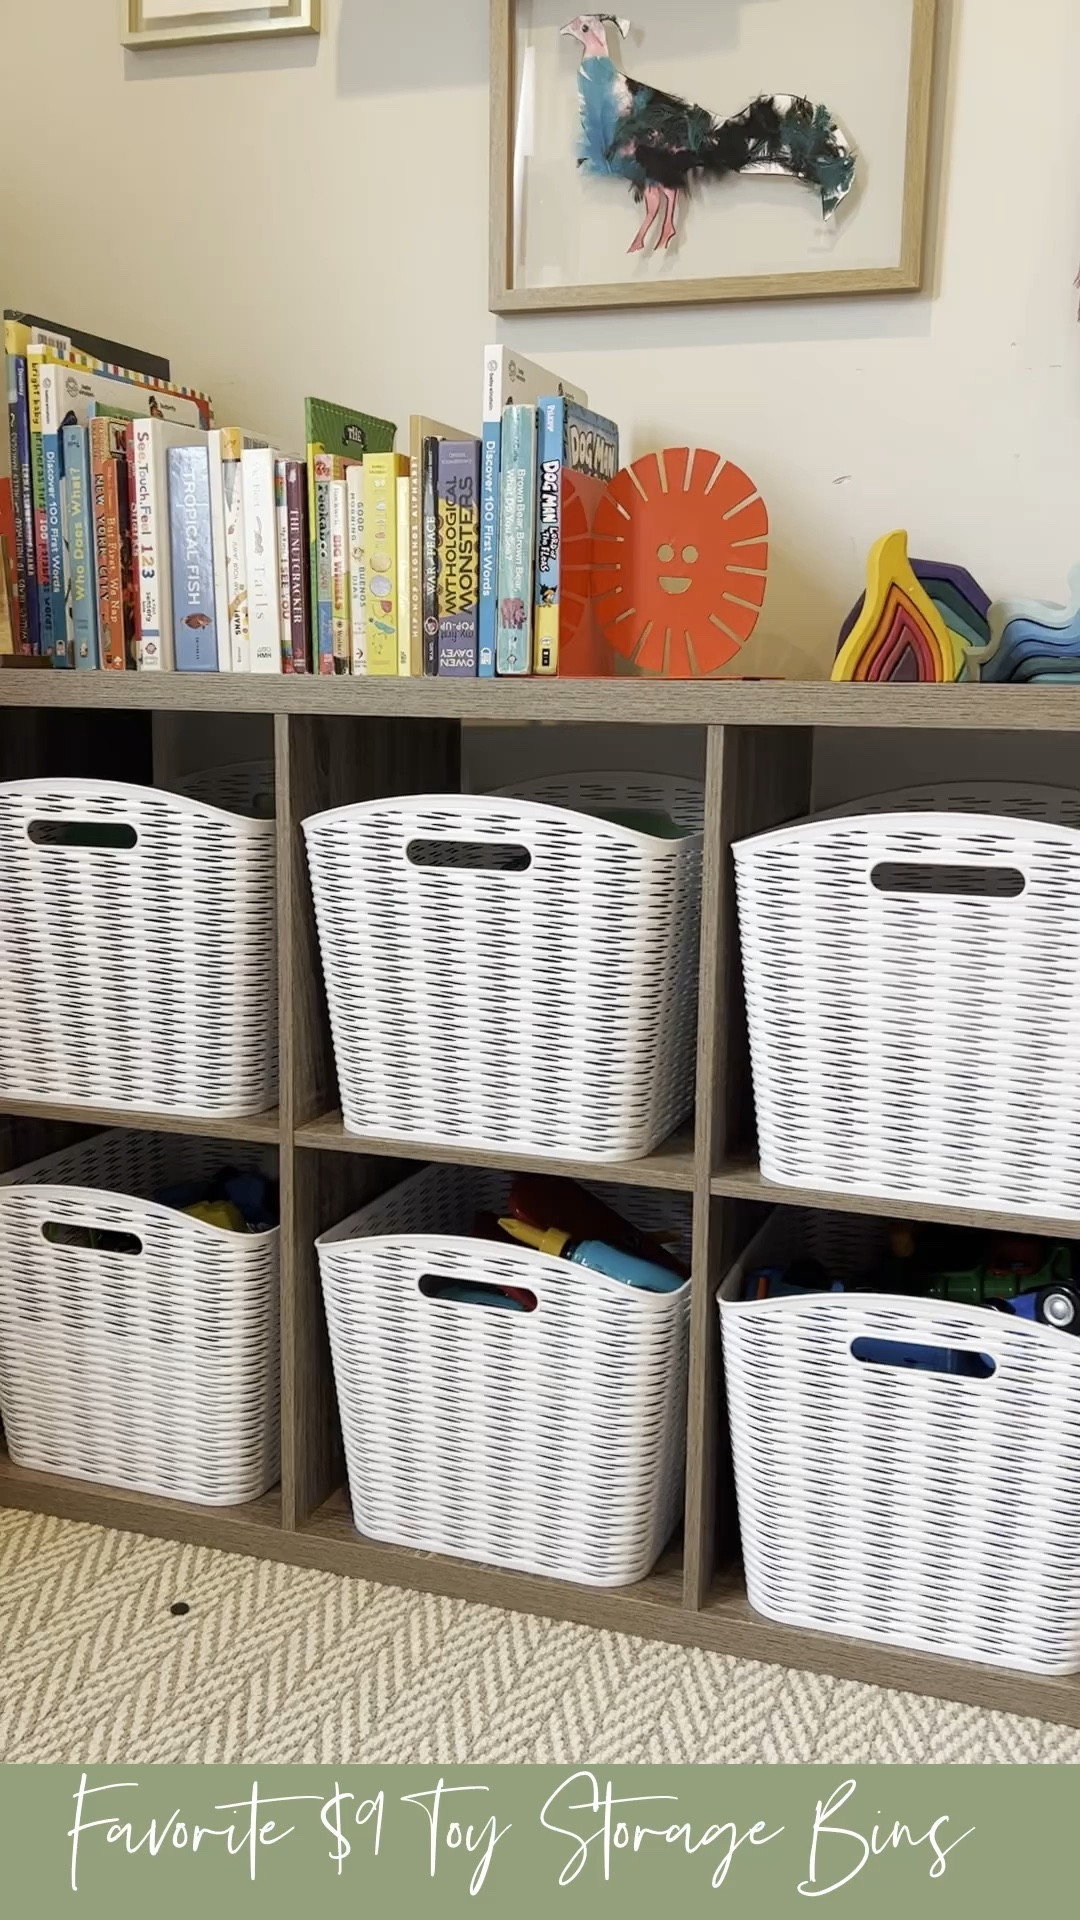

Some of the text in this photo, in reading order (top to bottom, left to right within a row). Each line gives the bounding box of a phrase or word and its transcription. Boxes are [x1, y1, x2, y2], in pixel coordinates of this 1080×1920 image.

[30, 362, 42, 425] bright baby
[569, 424, 616, 480] DOG MAN
[94, 473, 105, 506] NEW
[541, 459, 560, 523] DOG MAN
[39, 518, 49, 540] 100
[46, 451, 62, 593] Discover 100 First Words
[69, 467, 86, 601] Who Does What?
[96, 514, 108, 556] YORK
[106, 517, 117, 539] But
[140, 505, 152, 535] Feel
[356, 502, 365, 532] GOOD
[482, 440, 497, 596] Discover 100 First Words
[503, 468, 516, 561] What Do You See?
[512, 468, 527, 593] Brown Bear, Brown Bear,
[183, 469, 201, 605] TROPICAL FISH
[333, 534, 343, 558] BIG
[410, 455, 419, 638] HIP-HOP LEGENDS ALPHABET
[425, 515, 437, 556] PEACE
[445, 475, 457, 616] MYTHOLOGICAL
[458, 475, 474, 616] MONSTERS
[548, 526, 559, 549] LORD
[98, 565, 110, 602] CITY
[289, 508, 304, 623] THE NUTCRACKER
[426, 567, 437, 596] WAR
[109, 577, 120, 598] We
[253, 564, 269, 621] Tails
[358, 566, 367, 608] BUENOS
[110, 600, 121, 623] Nap
[233, 609, 242, 636] SNAP!
[440, 621, 475, 631] POP-UP
[440, 649, 474, 658] DAVEY
[440, 658, 475, 667] OWEN
